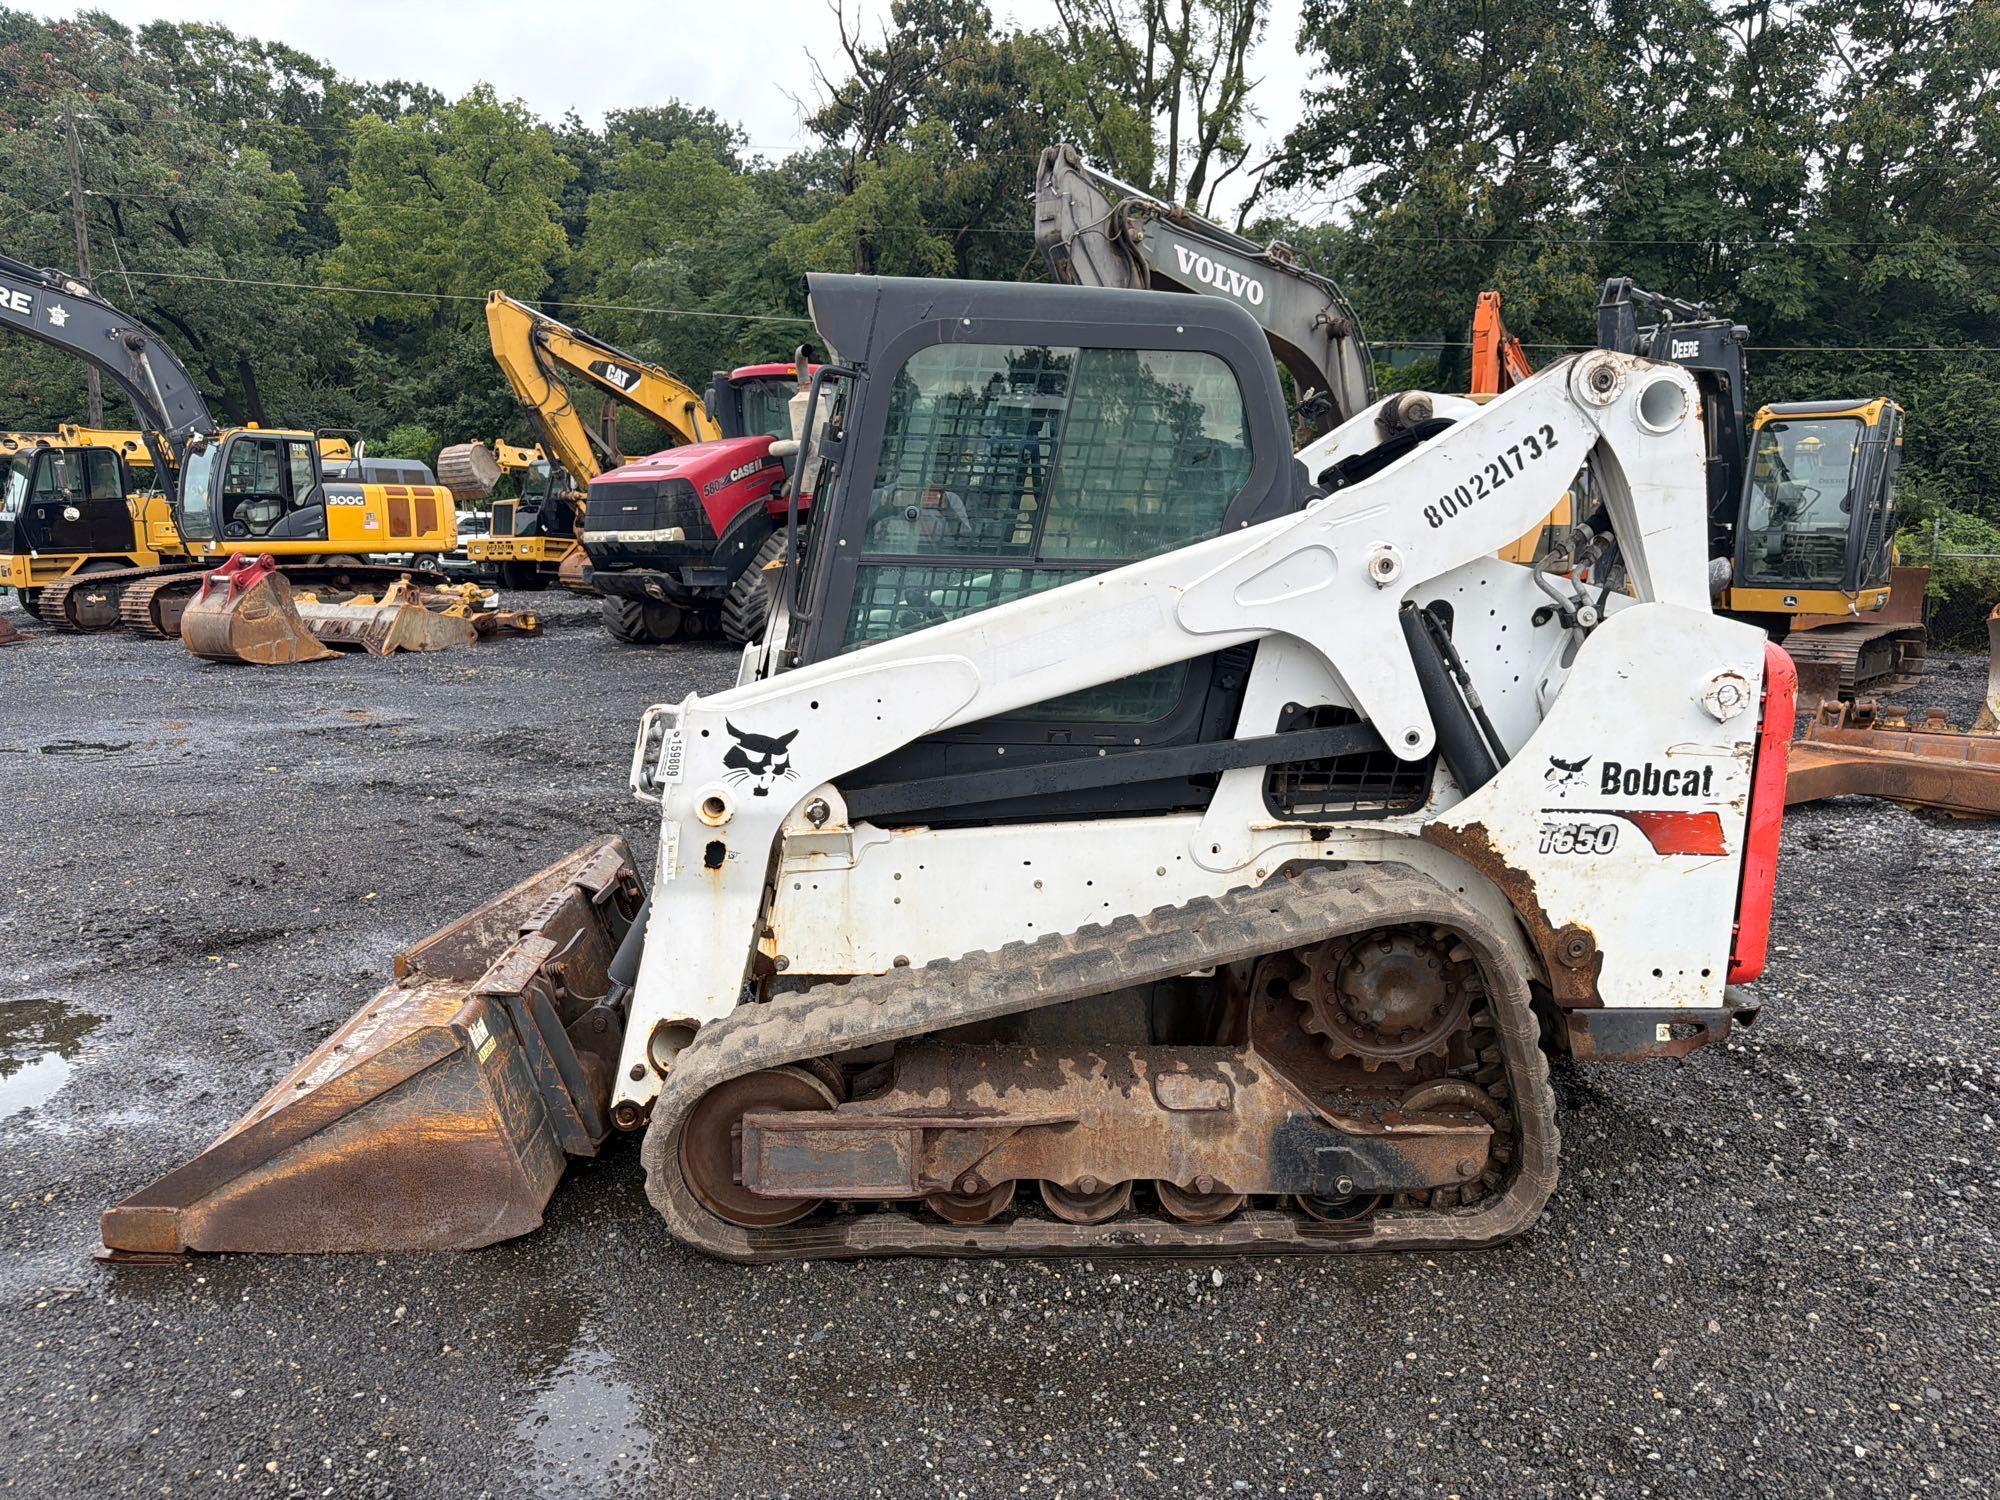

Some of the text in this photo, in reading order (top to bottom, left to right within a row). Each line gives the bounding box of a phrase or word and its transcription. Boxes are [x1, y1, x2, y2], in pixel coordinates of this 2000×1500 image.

[1173, 243, 1264, 306] VOLVO
[1671, 338, 1700, 359] DEERE
[605, 364, 630, 389] CAT
[730, 461, 755, 481] CASE
[1423, 424, 1559, 528] 800221732
[329, 495, 364, 505] 300G
[703, 479, 721, 498] 580
[666, 739, 683, 777] 159809
[1600, 761, 1714, 797] Bobcat
[1538, 822, 1619, 855] T650
